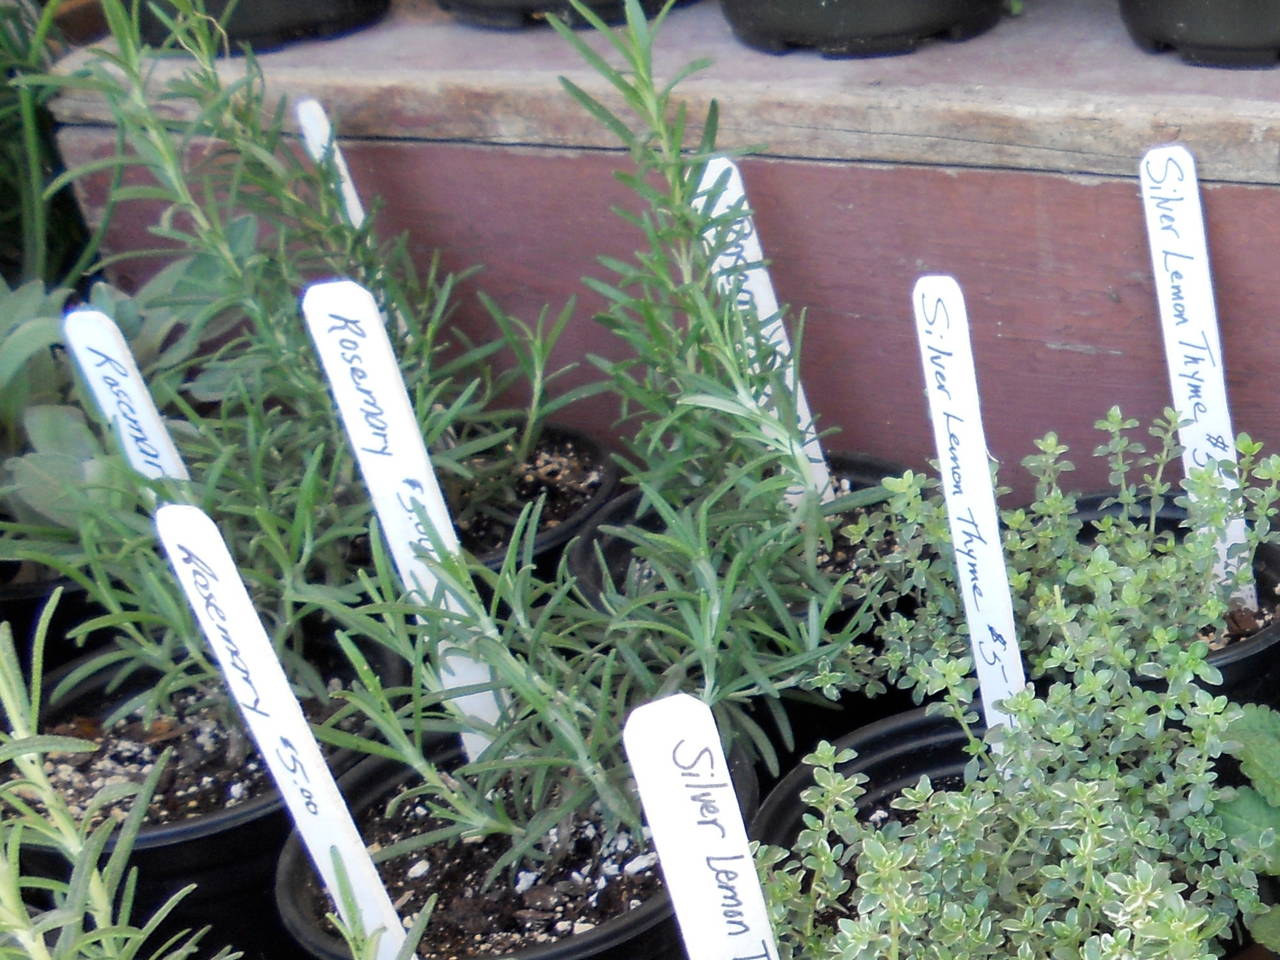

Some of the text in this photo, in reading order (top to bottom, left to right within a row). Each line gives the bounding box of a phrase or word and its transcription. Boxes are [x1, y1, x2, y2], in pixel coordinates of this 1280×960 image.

[1146, 157, 1184, 239] Silver
[1162, 250, 1194, 326] Lemon
[87, 346, 165, 475] Rosemar
[327, 313, 393, 457] Rosemary
[1179, 330, 1216, 423] Thyme
[922, 293, 953, 401] Silver
[943, 411, 964, 496] Lemon
[955, 507, 988, 613] Thyme
[177, 544, 270, 717] Rosemary
[672, 739, 729, 840] Silver
[705, 854, 750, 937] Lemon
